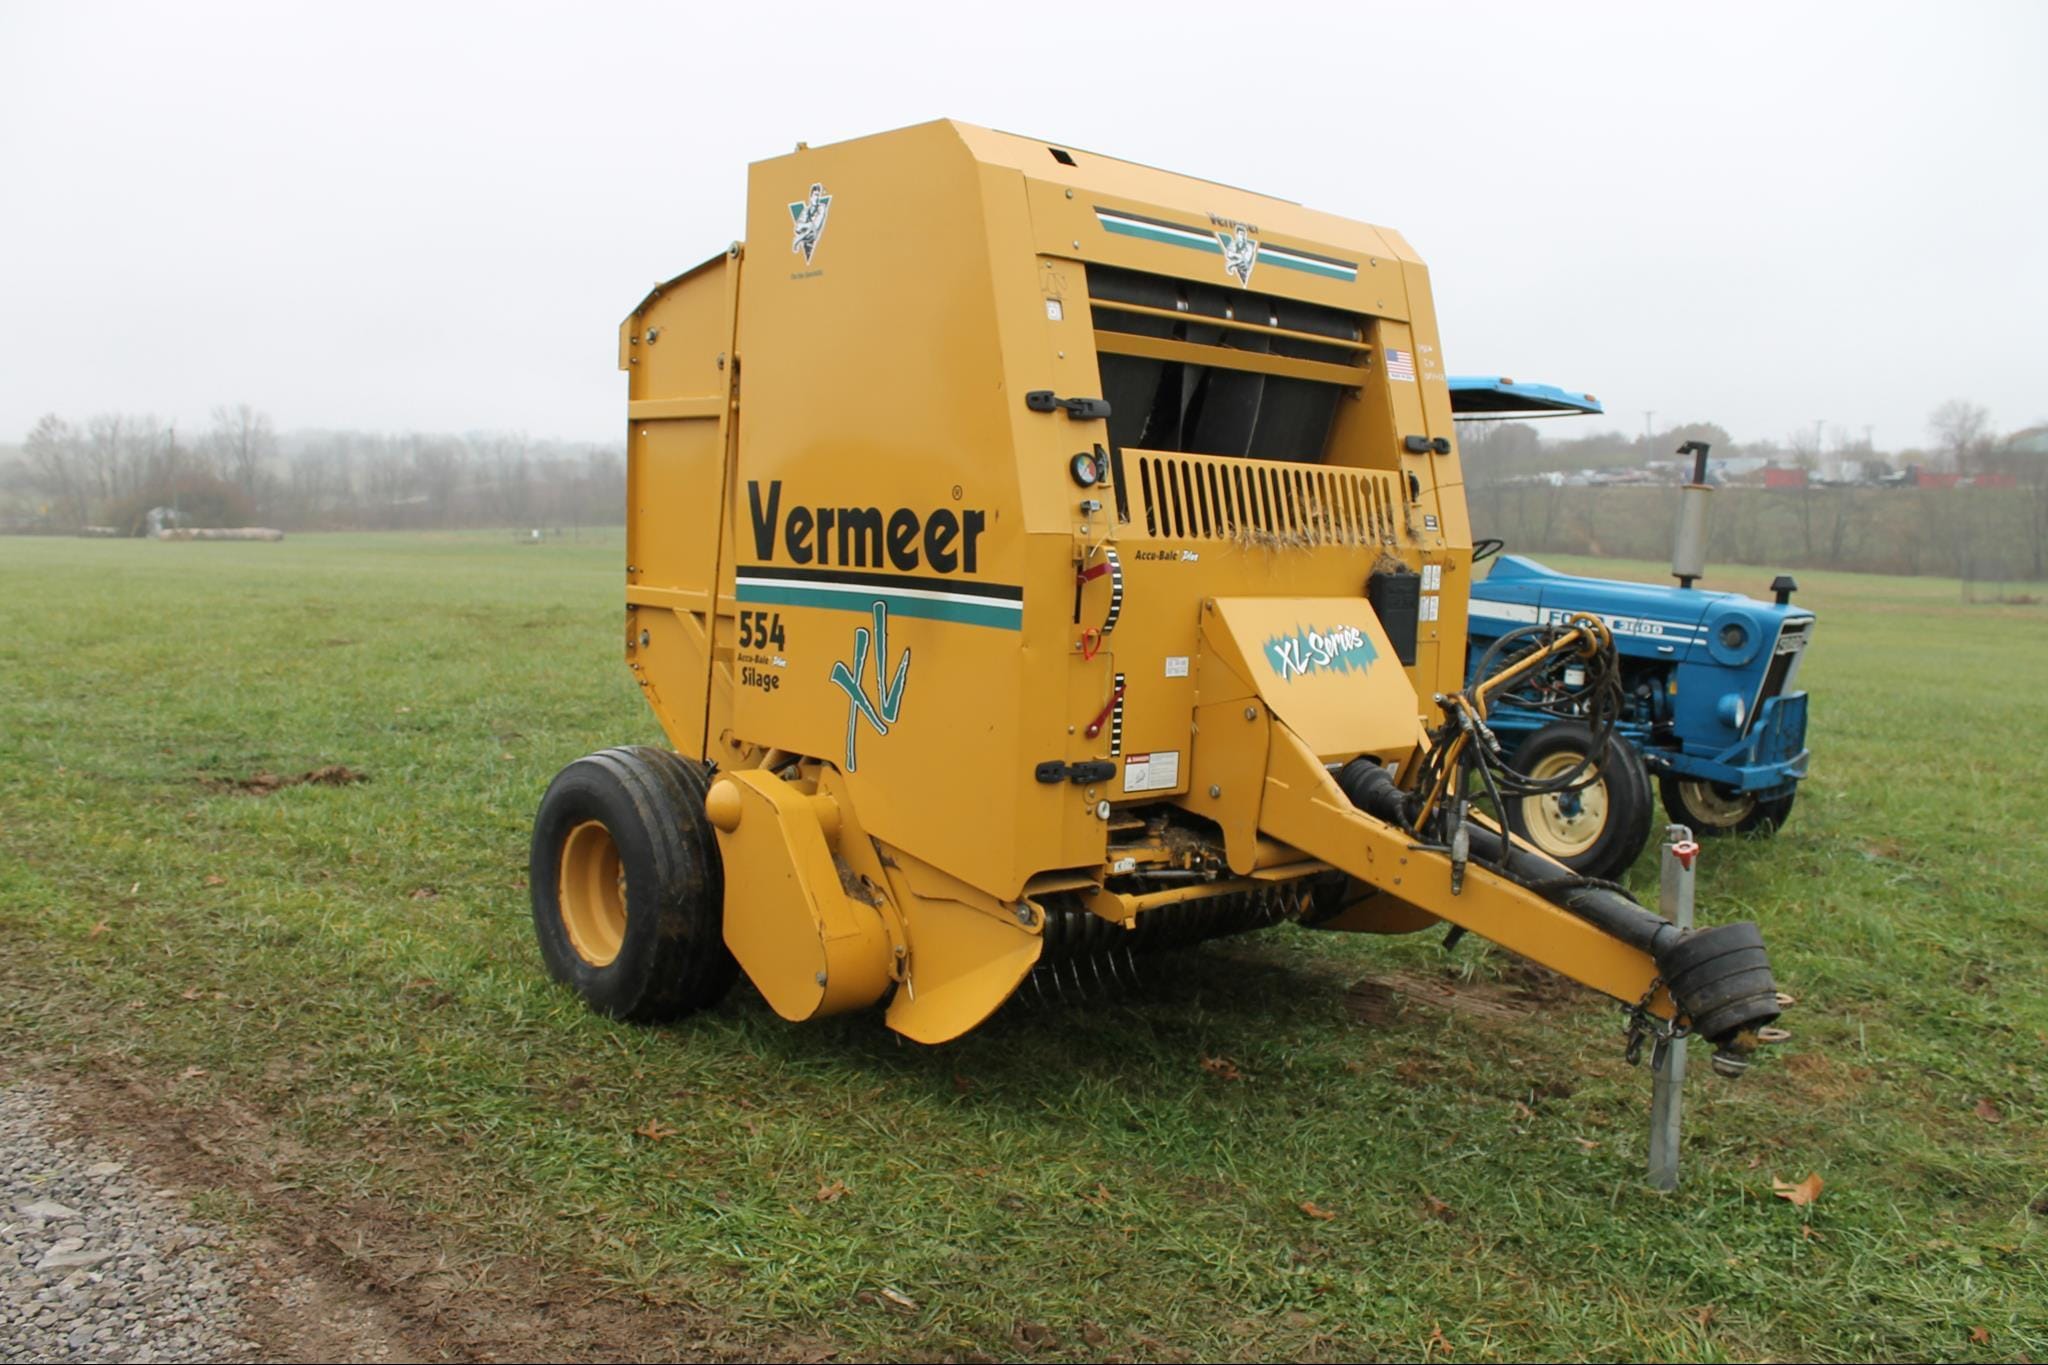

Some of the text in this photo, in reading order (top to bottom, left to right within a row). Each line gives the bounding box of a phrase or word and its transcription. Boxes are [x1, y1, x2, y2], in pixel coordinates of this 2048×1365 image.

[747, 480, 985, 574] Vermeer
[738, 610, 785, 652] 554
[1273, 624, 1364, 679] XL Series
[742, 666, 780, 693] Silage
[829, 600, 911, 772] XL
